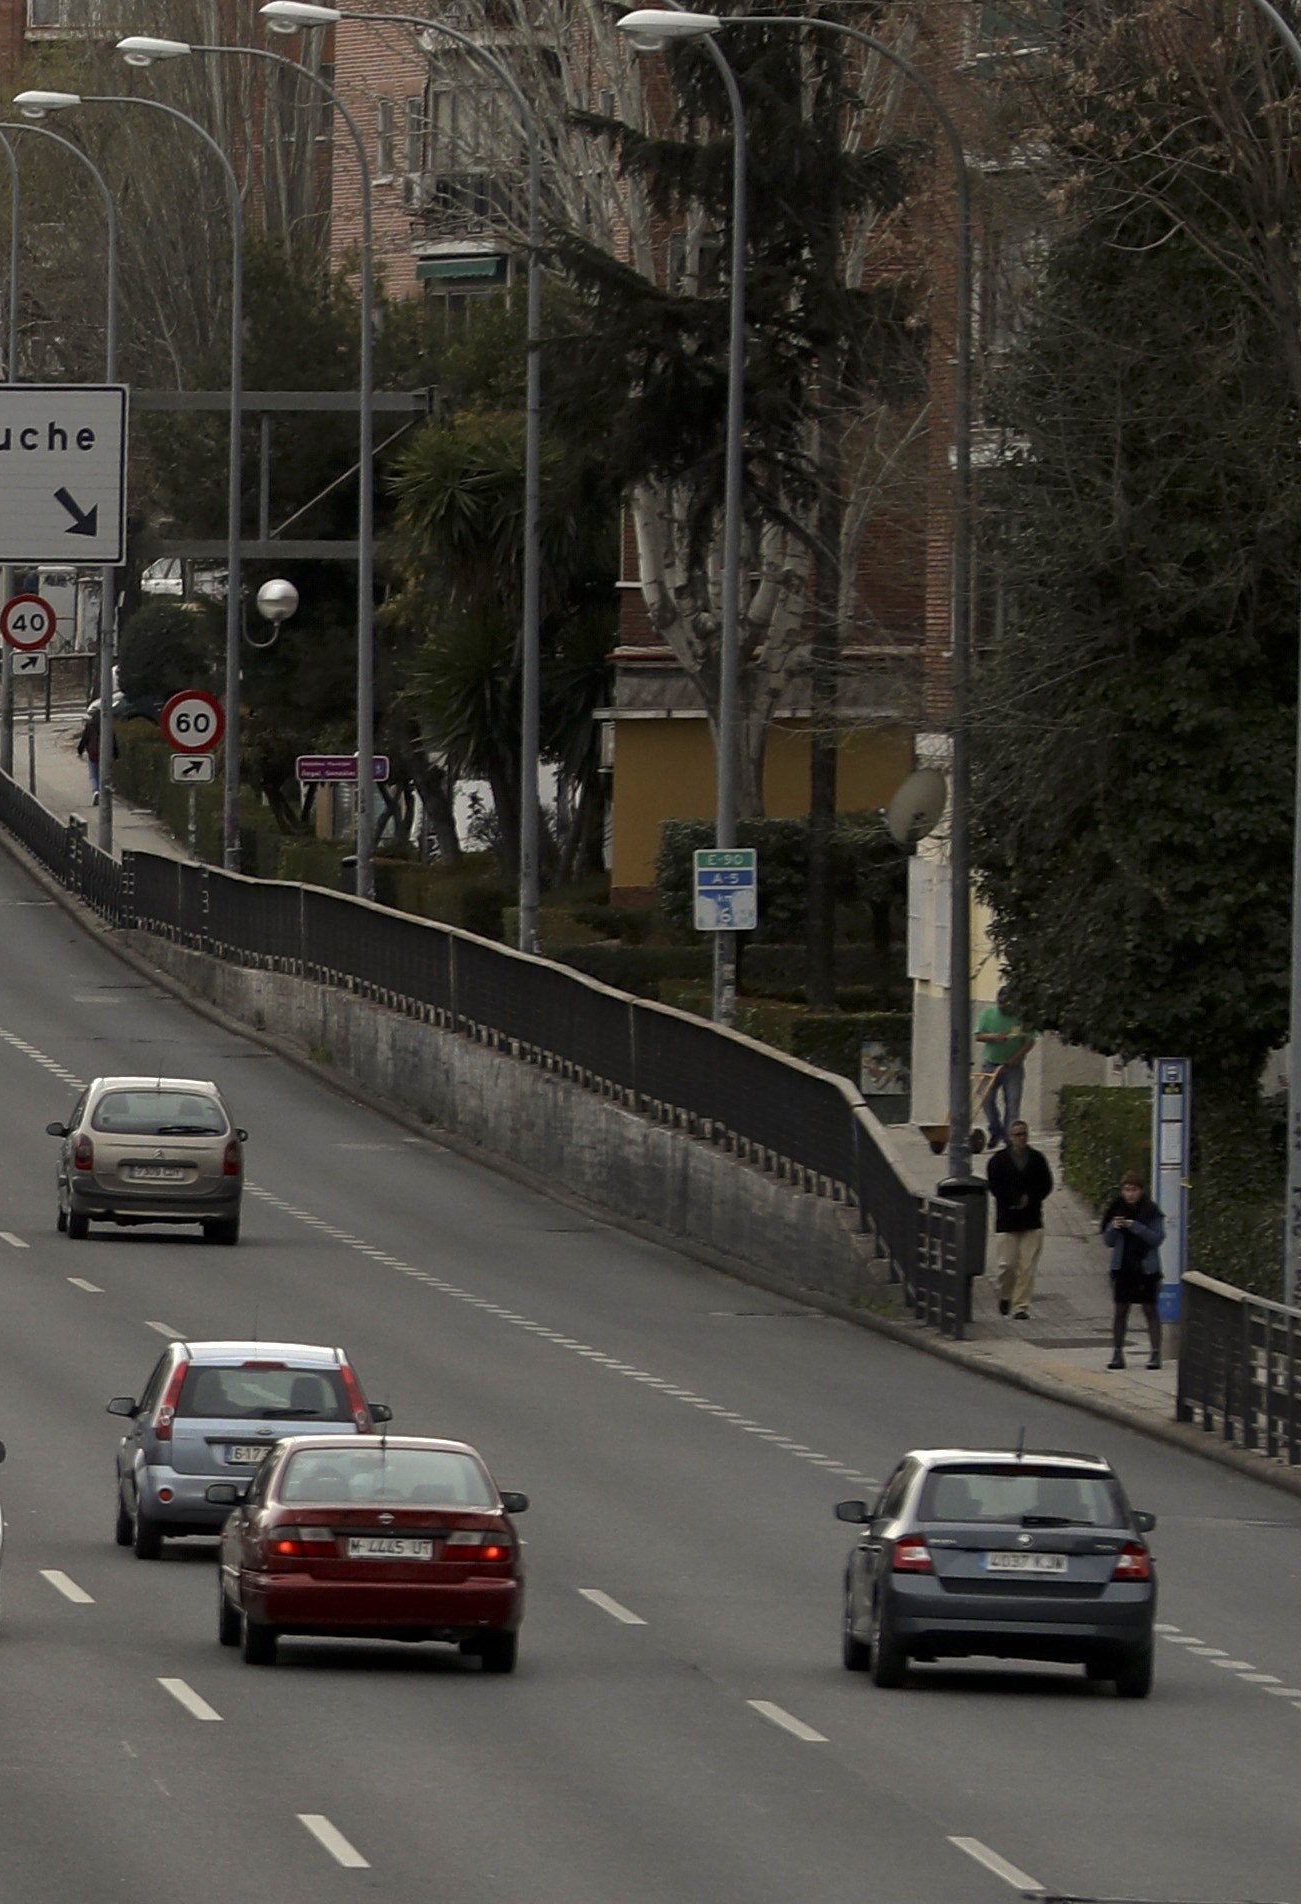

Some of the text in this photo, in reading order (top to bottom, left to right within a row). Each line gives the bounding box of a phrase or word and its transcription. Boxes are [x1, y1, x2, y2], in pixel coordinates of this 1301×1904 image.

[12, 613, 45, 634] 40
[176, 713, 210, 734] 60
[707, 854, 743, 866] E-90
[712, 873, 739, 884] A-5
[721, 907, 732, 923] 6
